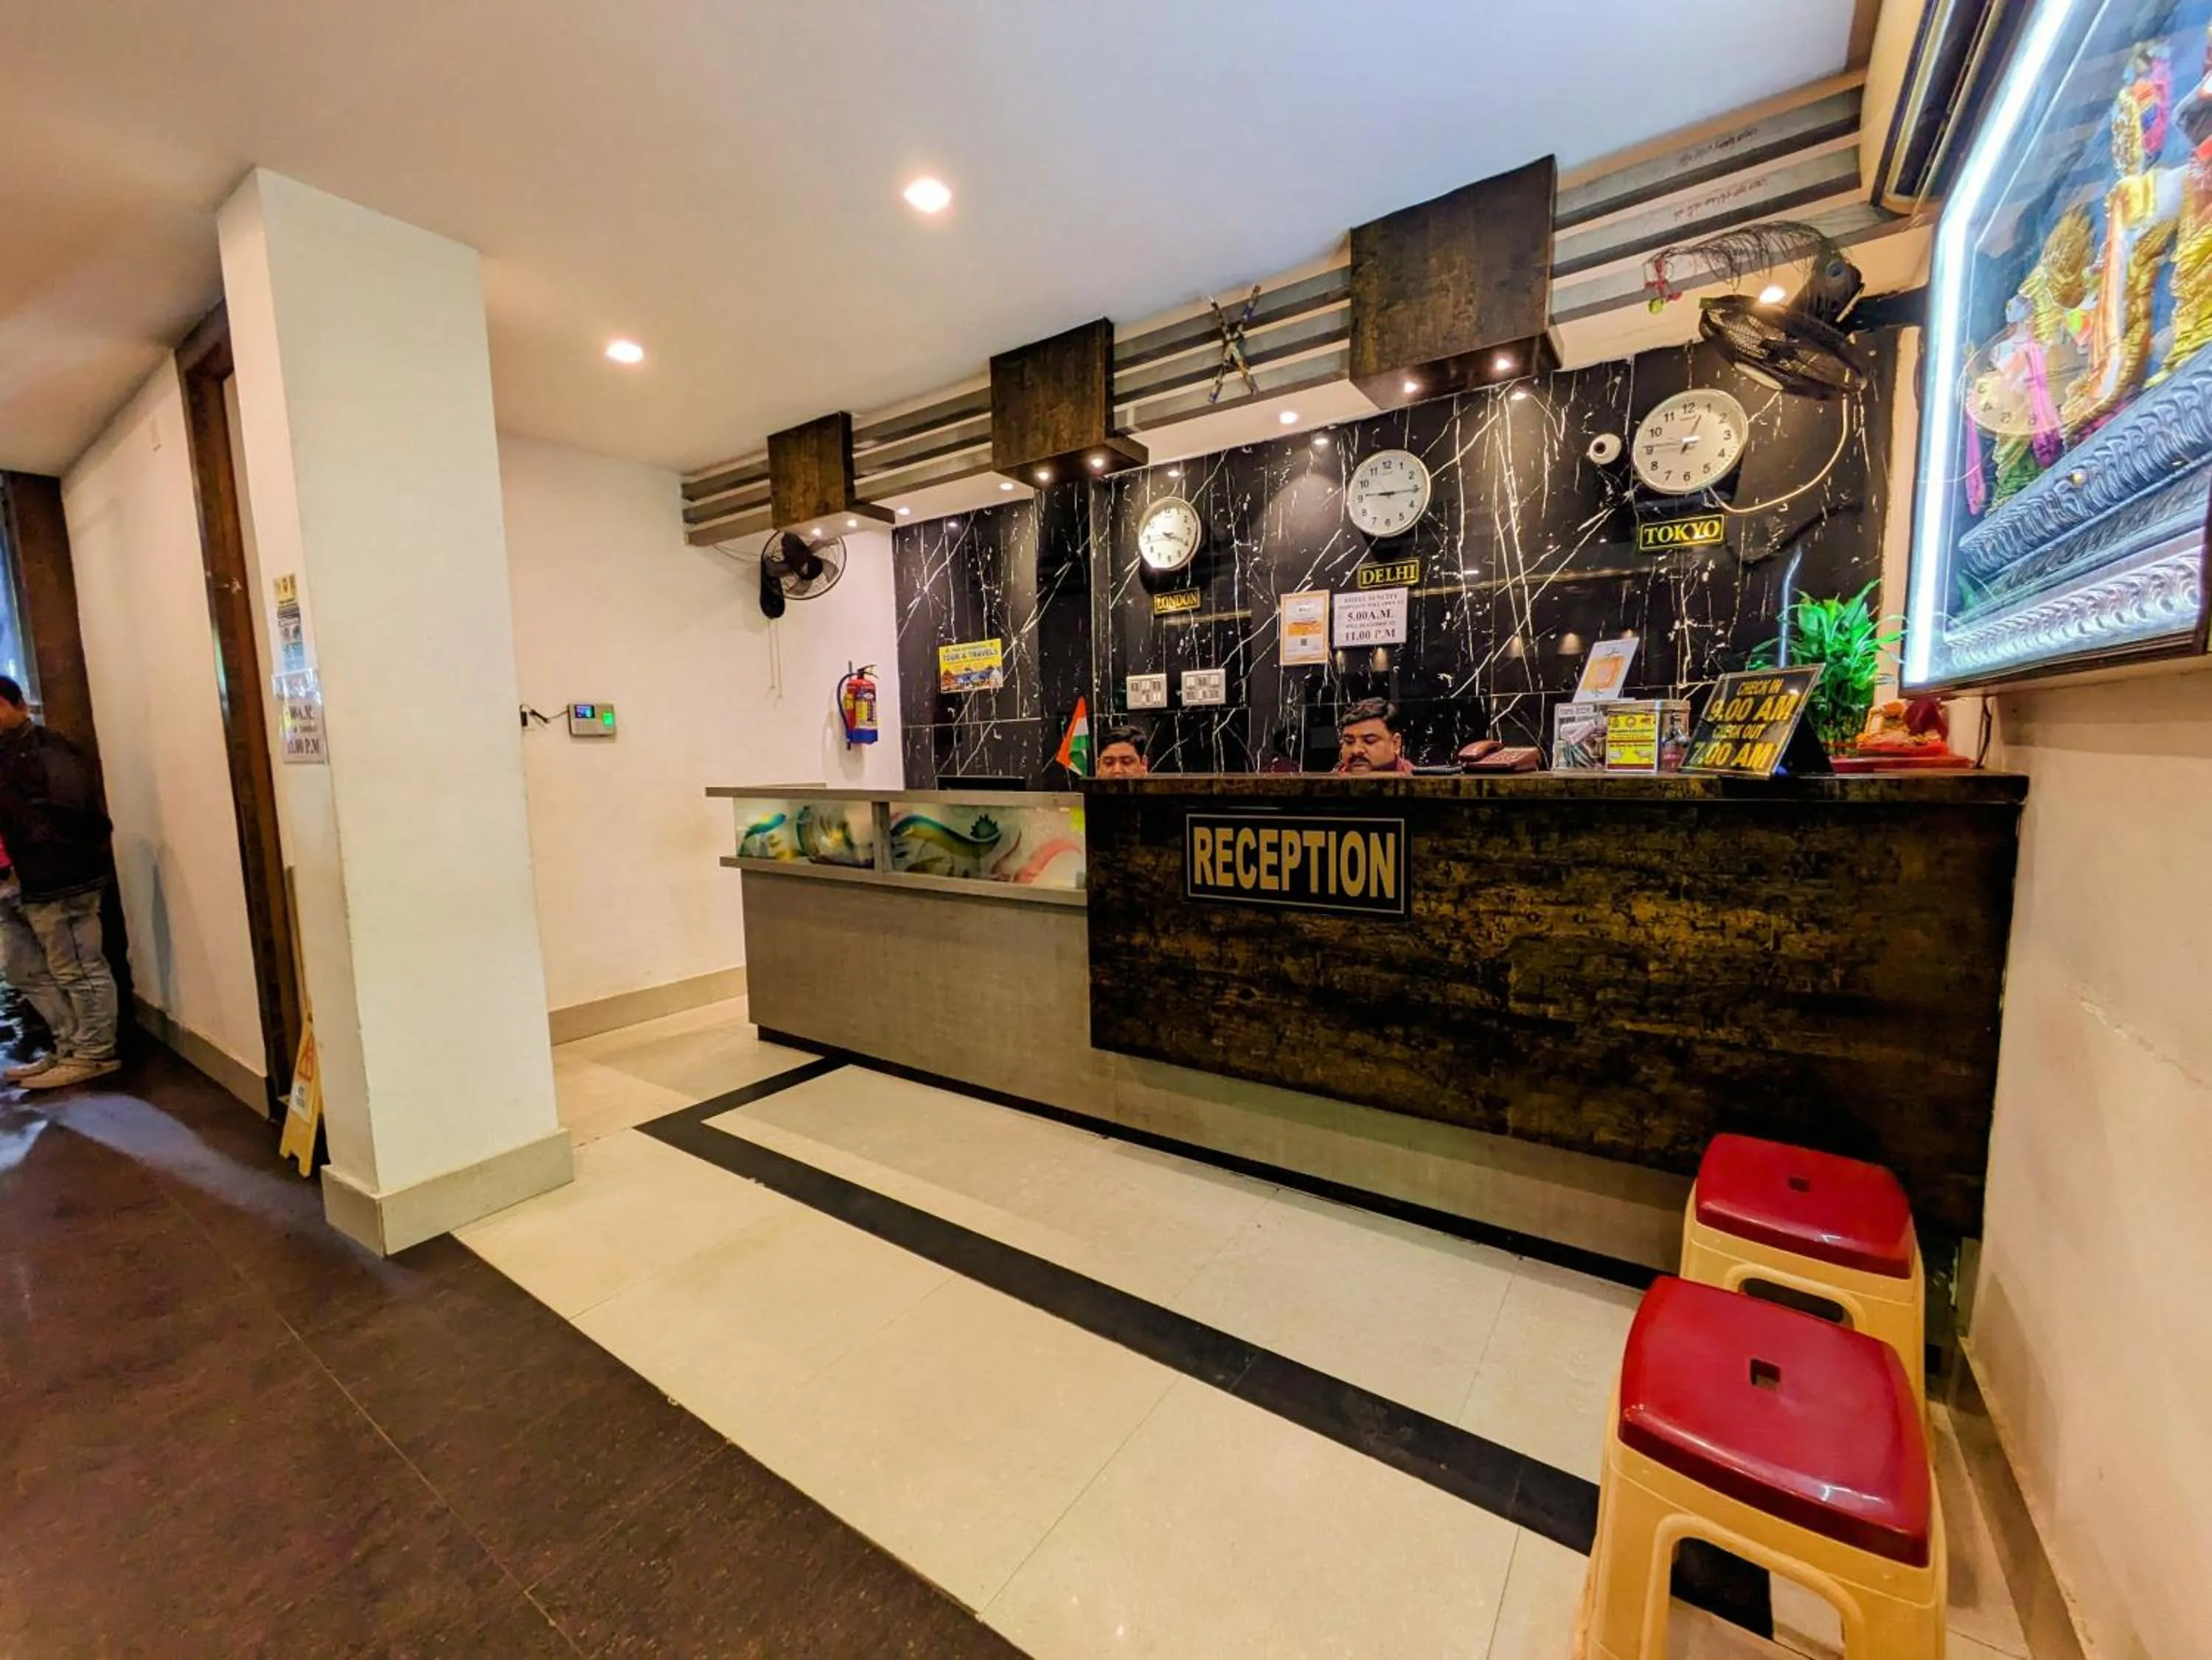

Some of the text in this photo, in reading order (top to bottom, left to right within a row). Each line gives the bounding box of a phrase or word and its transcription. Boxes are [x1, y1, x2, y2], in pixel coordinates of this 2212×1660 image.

[1683, 402, 1695, 414] 12
[1706, 403, 1711, 413] 1
[1663, 412, 1674, 422] 11
[1719, 413, 1728, 423] 2
[1650, 427, 1662, 438] 10
[1724, 430, 1731, 440] 3
[1717, 448, 1725, 457] 4
[1382, 460, 1392, 469] 12
[1399, 461, 1403, 470] 1
[1651, 461, 1658, 471] 8
[1703, 463, 1711, 474] 5
[1371, 467, 1377, 477] 11
[1408, 471, 1415, 480] 2
[1665, 470, 1673, 481] 7
[1683, 472, 1691, 481] 6
[1360, 480, 1369, 489] 10
[1357, 495, 1363, 503] 9
[1408, 499, 1414, 508] 4
[1372, 517, 1377, 525] 7
[1399, 512, 1404, 520] 5
[1644, 520, 1720, 544] TOKYO
[1362, 565, 1416, 585] DELHI
[1157, 592, 1197, 610] LONDON
[1346, 631, 1371, 641] 11.00
[1736, 678, 1784, 696] CHECK IN
[1706, 694, 1801, 722] 9.00 AM
[1712, 723, 1767, 739] CHECK OUT
[1689, 741, 1777, 769] 7.00 AM
[1193, 826, 1396, 899] RECEPTION
